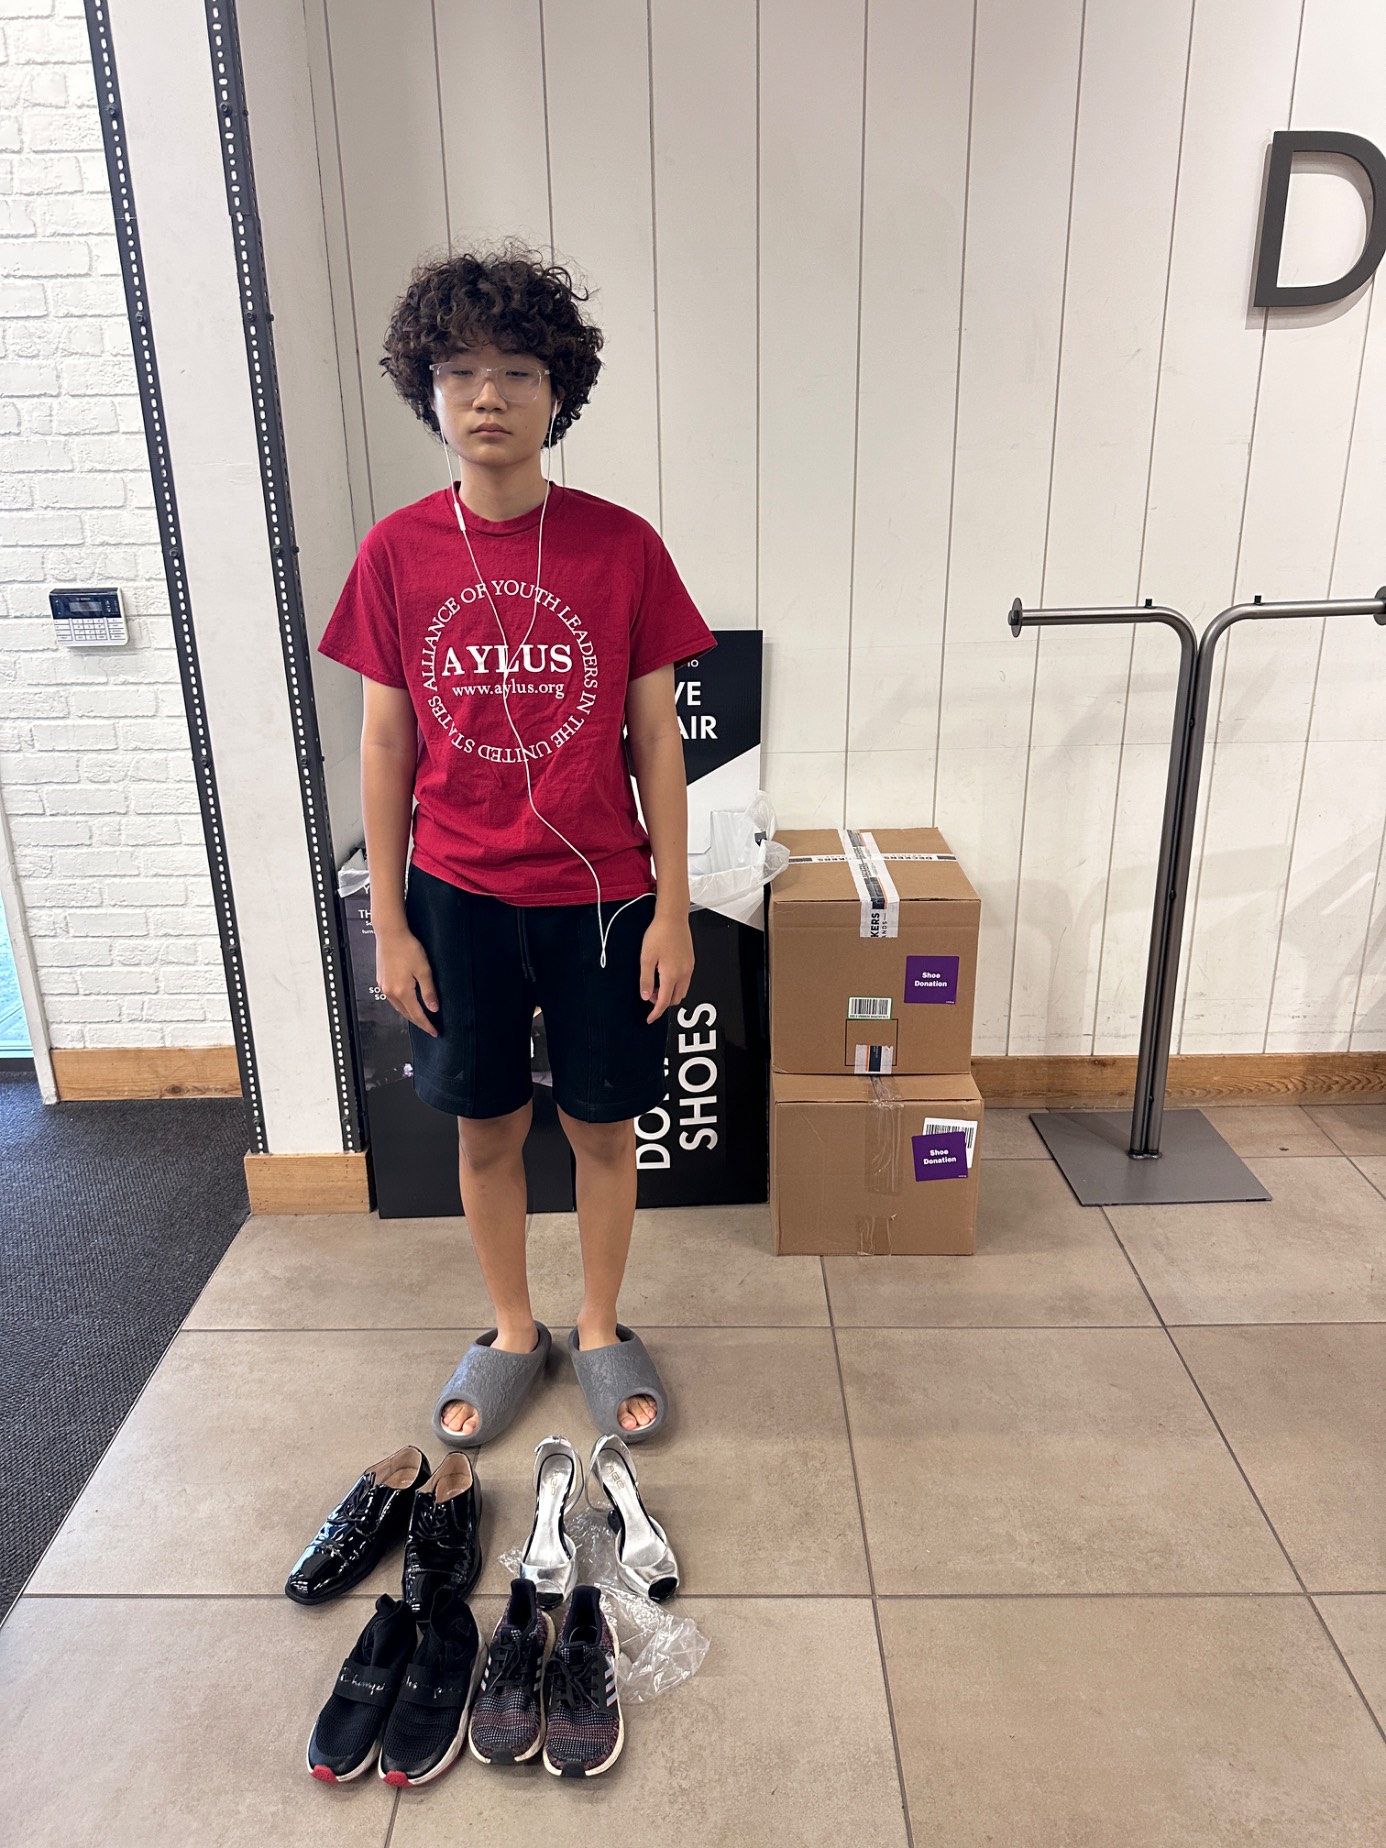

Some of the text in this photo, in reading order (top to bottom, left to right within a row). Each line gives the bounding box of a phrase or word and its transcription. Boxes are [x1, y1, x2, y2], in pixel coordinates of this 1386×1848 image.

[1253, 130, 1386, 307] D
[422, 580, 598, 763] ALLIANCE OF YOUTH LEADERS IN THE UNITED STATES
[442, 644, 573, 676] AYLUS
[452, 679, 565, 699] www.aylus.org
[922, 971, 941, 979] Shoe
[677, 1003, 718, 1151] SHOES
[923, 1156, 957, 1165] Donation
